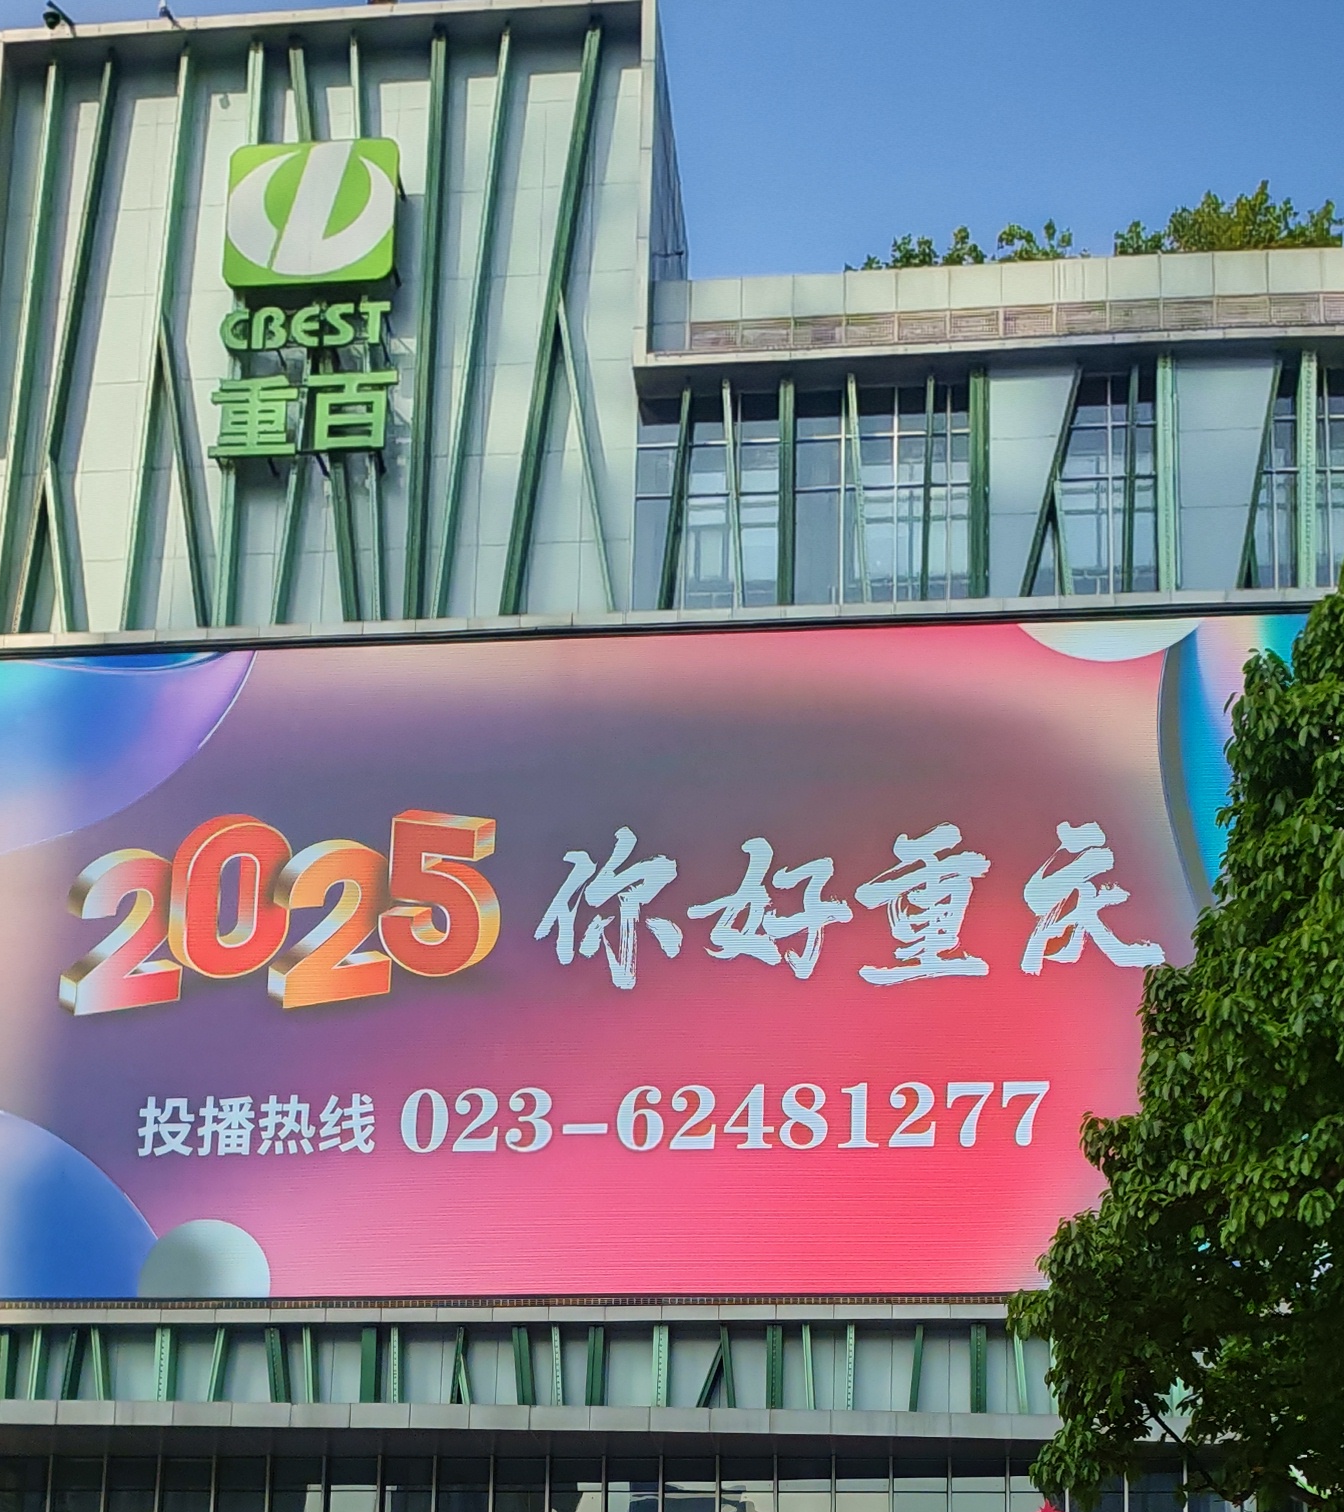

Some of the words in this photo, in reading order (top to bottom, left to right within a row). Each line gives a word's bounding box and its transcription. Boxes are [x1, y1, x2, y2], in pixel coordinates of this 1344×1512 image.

[220, 301, 392, 349] CBEST
[208, 370, 399, 459] 重百
[58, 809, 501, 1017] 2025
[533, 822, 1167, 989] 你好重庆
[137, 1092, 376, 1157] 投播热线
[400, 1080, 1051, 1154] 023-62481277
